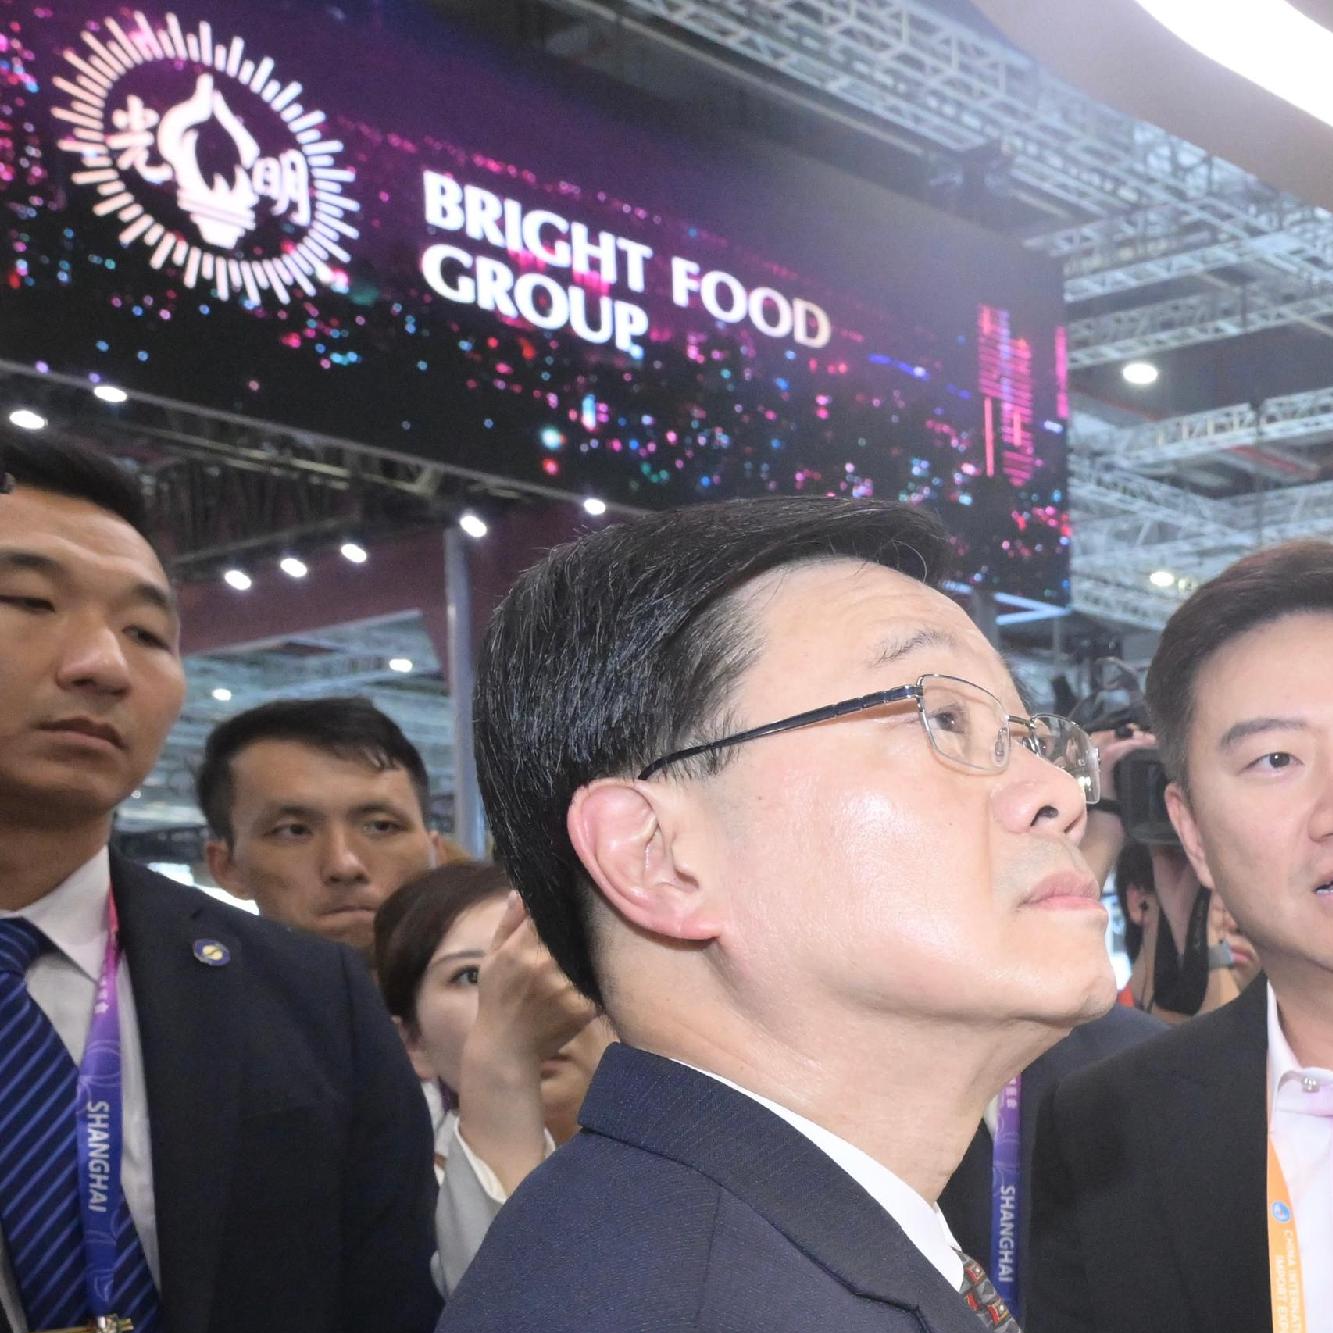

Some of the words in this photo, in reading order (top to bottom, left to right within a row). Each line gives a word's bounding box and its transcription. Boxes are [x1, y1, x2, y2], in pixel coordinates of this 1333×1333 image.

[421, 243, 649, 352] GROUP
[422, 169, 653, 293] BRIGHT
[671, 260, 832, 349] FOOD
[87, 1100, 110, 1213] SHANGHAI
[998, 1185, 1016, 1283] SHANGHAI
